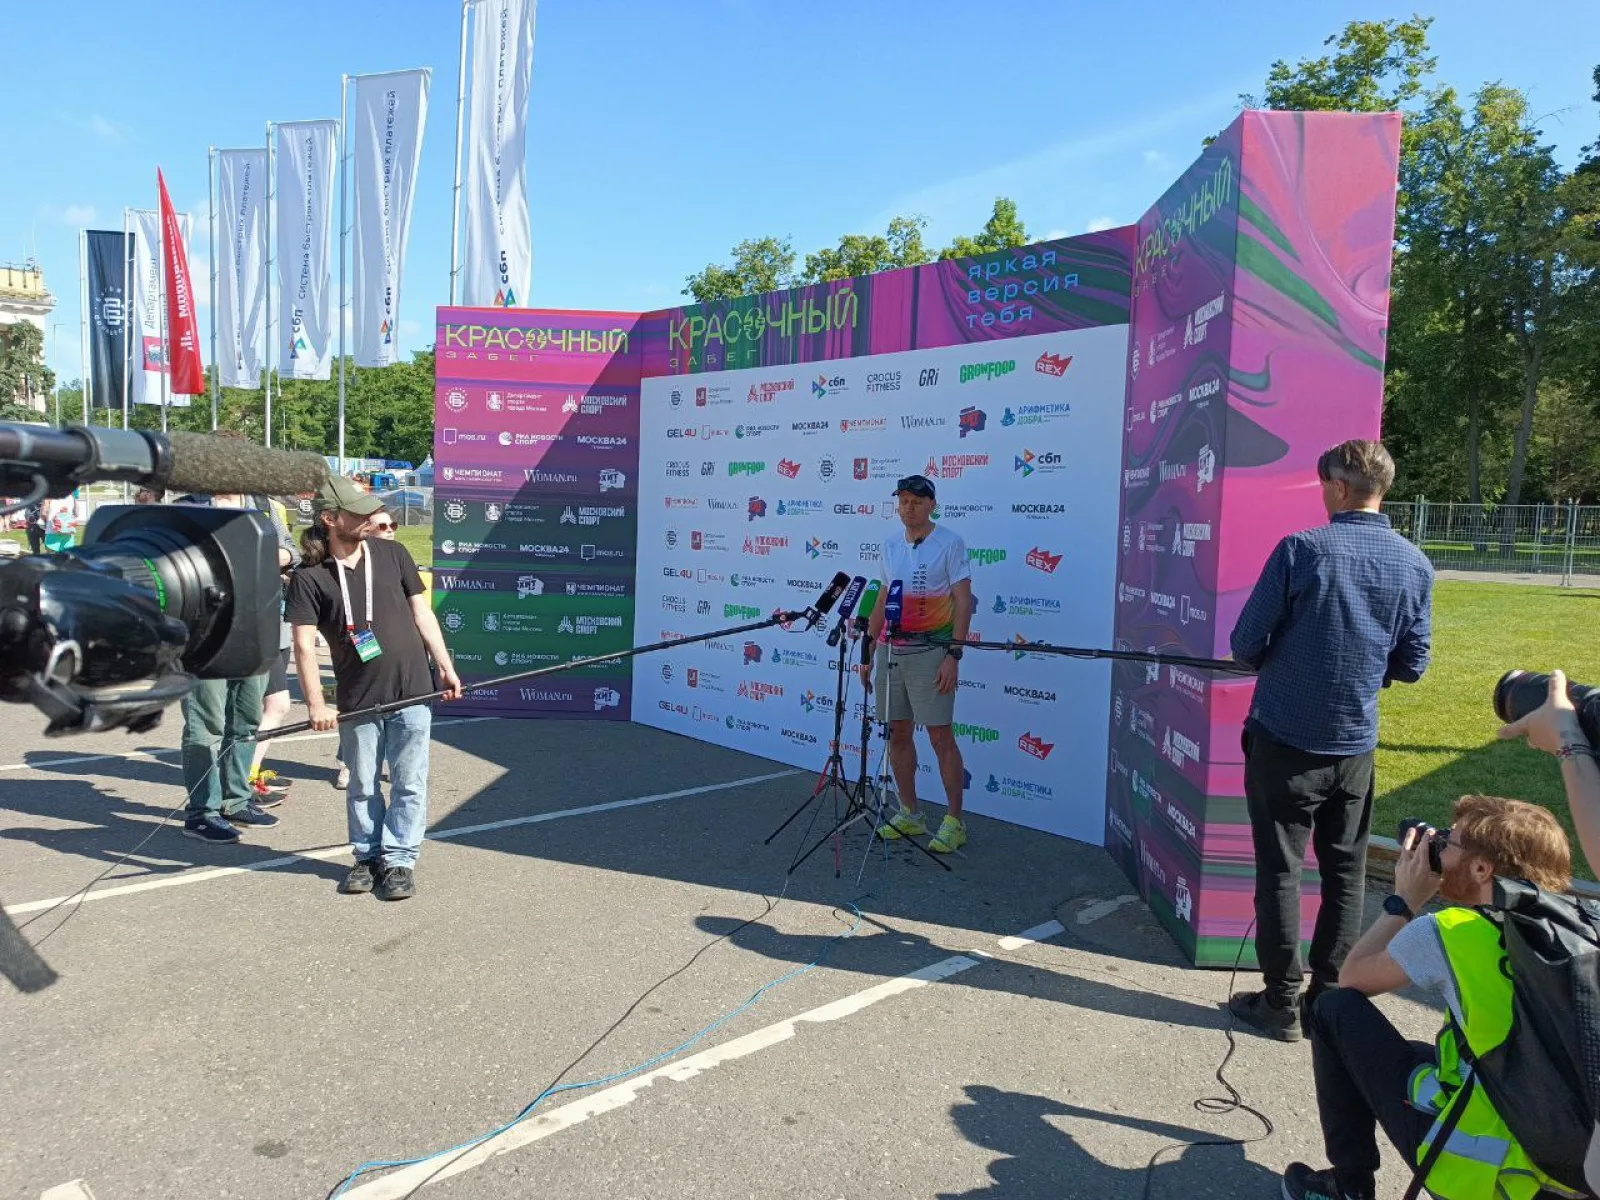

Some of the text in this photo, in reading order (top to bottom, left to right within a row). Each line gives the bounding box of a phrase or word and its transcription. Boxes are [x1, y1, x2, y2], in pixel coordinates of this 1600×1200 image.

[386, 91, 396, 153] платежей
[384, 158, 392, 216] быстрых
[1135, 155, 1231, 277] КРАСОЧНЫЙ
[300, 198, 312, 251] быстрых
[500, 250, 509, 284] сбп
[968, 251, 1057, 281] яркая
[299, 253, 311, 300] система
[967, 273, 1079, 304] версия
[384, 286, 392, 315] сбп
[292, 309, 304, 333] сбп
[669, 287, 859, 350] КРАСОЧНЫЙ
[966, 304, 1034, 329] тебя
[445, 324, 628, 354] КРАСОЧНЫЙ
[445, 350, 539, 362] ЗАБЕГ
[669, 349, 757, 368] ЗАБЕГ
[960, 360, 1015, 383] GROWFOOD
[1036, 362, 1061, 375] REX
[829, 376, 846, 386] сбп
[866, 371, 901, 384] CROCUS
[919, 368, 940, 387] GRi
[866, 382, 900, 392] FITNESS
[581, 395, 627, 406] МОСКОВСКИЙ
[581, 405, 603, 414] СПОРТ
[1018, 403, 1070, 414] АРИФМЕТИКА
[792, 421, 829, 431] МОСКВА24
[1018, 414, 1042, 426] ДОБРА
[666, 428, 697, 438] GEL4U
[577, 436, 627, 445] МОСКВА24
[942, 451, 989, 466] МОСКОВСКИЙ
[1038, 452, 1061, 464] сбп
[455, 469, 502, 477] ЧЕМПИОНАТ
[942, 467, 963, 478] СПОРТ
[579, 506, 625, 517] МОСКОВСКИЙ
[833, 504, 874, 515] GEL4U
[960, 504, 993, 512] НОВОСТИ
[1012, 504, 1066, 513] МОСКВА24
[579, 516, 600, 525] СПОРТ
[519, 545, 570, 554] МОСКВА24
[822, 540, 838, 550] сбп
[860, 543, 881, 552] CROC
[1027, 555, 1052, 572] REX
[663, 567, 692, 579] GEL4U
[577, 584, 625, 592] ЧЕМПИОНАТ
[787, 579, 823, 590] МОСКВА24
[1009, 595, 1060, 608] АРИФМЕТИКА
[1008, 606, 1033, 616] ДОБРА
[575, 615, 622, 627] МОСКОВСКИЙ
[575, 626, 598, 635] СПОРТ
[957, 680, 985, 689] ОВОСТИ
[1004, 685, 1056, 702] МОСКВА24
[816, 695, 833, 706] сбп
[659, 700, 689, 715] GEL4U
[781, 728, 817, 743] МОСКВА24
[1020, 740, 1044, 758] REX
[1002, 777, 1052, 795] АРИФМЕТИКА
[1001, 787, 1026, 799] ДОБРА
